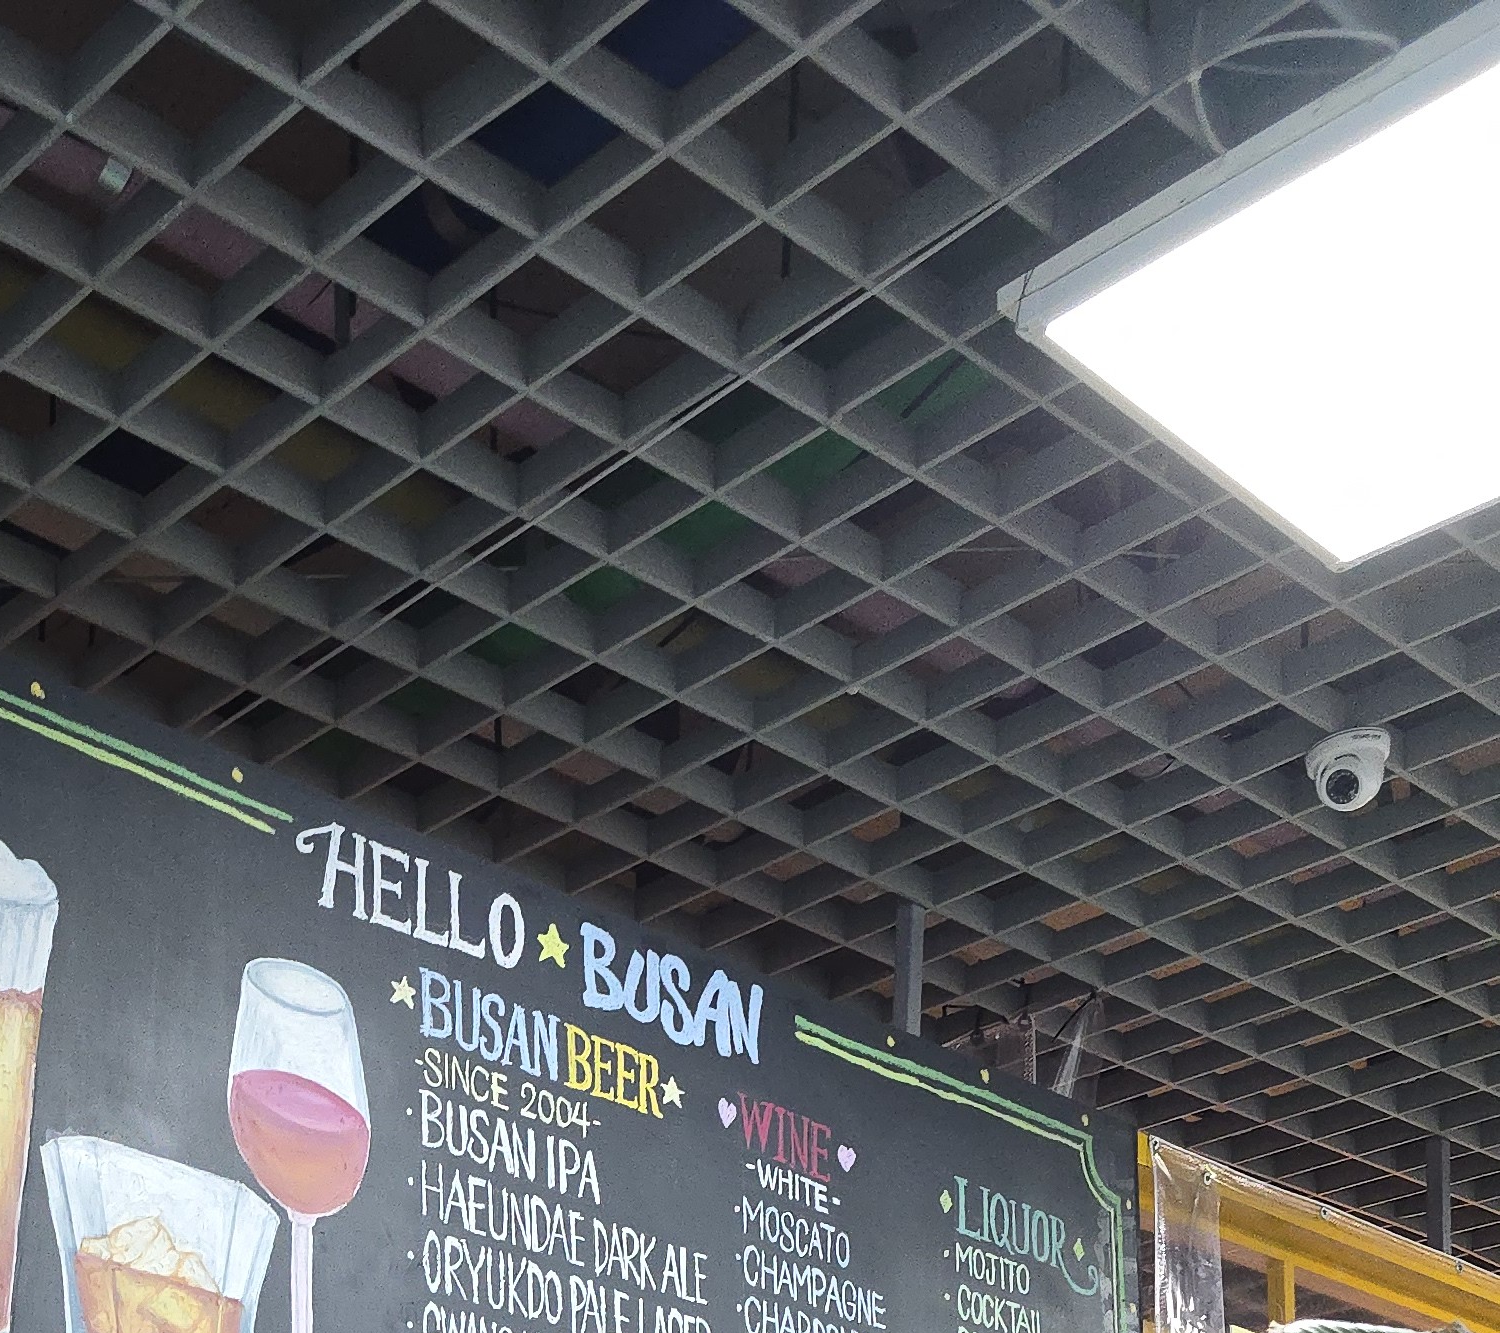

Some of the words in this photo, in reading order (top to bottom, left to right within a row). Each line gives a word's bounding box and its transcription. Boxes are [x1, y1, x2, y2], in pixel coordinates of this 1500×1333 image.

[296, 822, 525, 969] HELLO
[580, 921, 763, 1065] BUSAN
[419, 967, 560, 1082] BUSAN
[565, 1022, 664, 1119] BEER
[419, 1088, 536, 1182] BUSAN
[548, 1135, 601, 1205] IPA
[738, 1092, 832, 1184] WINE
[421, 1159, 585, 1268] HAEUNDAE
[594, 1217, 657, 1291] DARK
[661, 1243, 708, 1306] ALE
[423, 1229, 564, 1325] ORYUKDO
[741, 1194, 851, 1269] MOSCATO
[955, 1176, 1099, 1296] LIQUOR
[956, 1242, 1031, 1295] MOJITO
[743, 1245, 888, 1331] CHAMPAGNE
